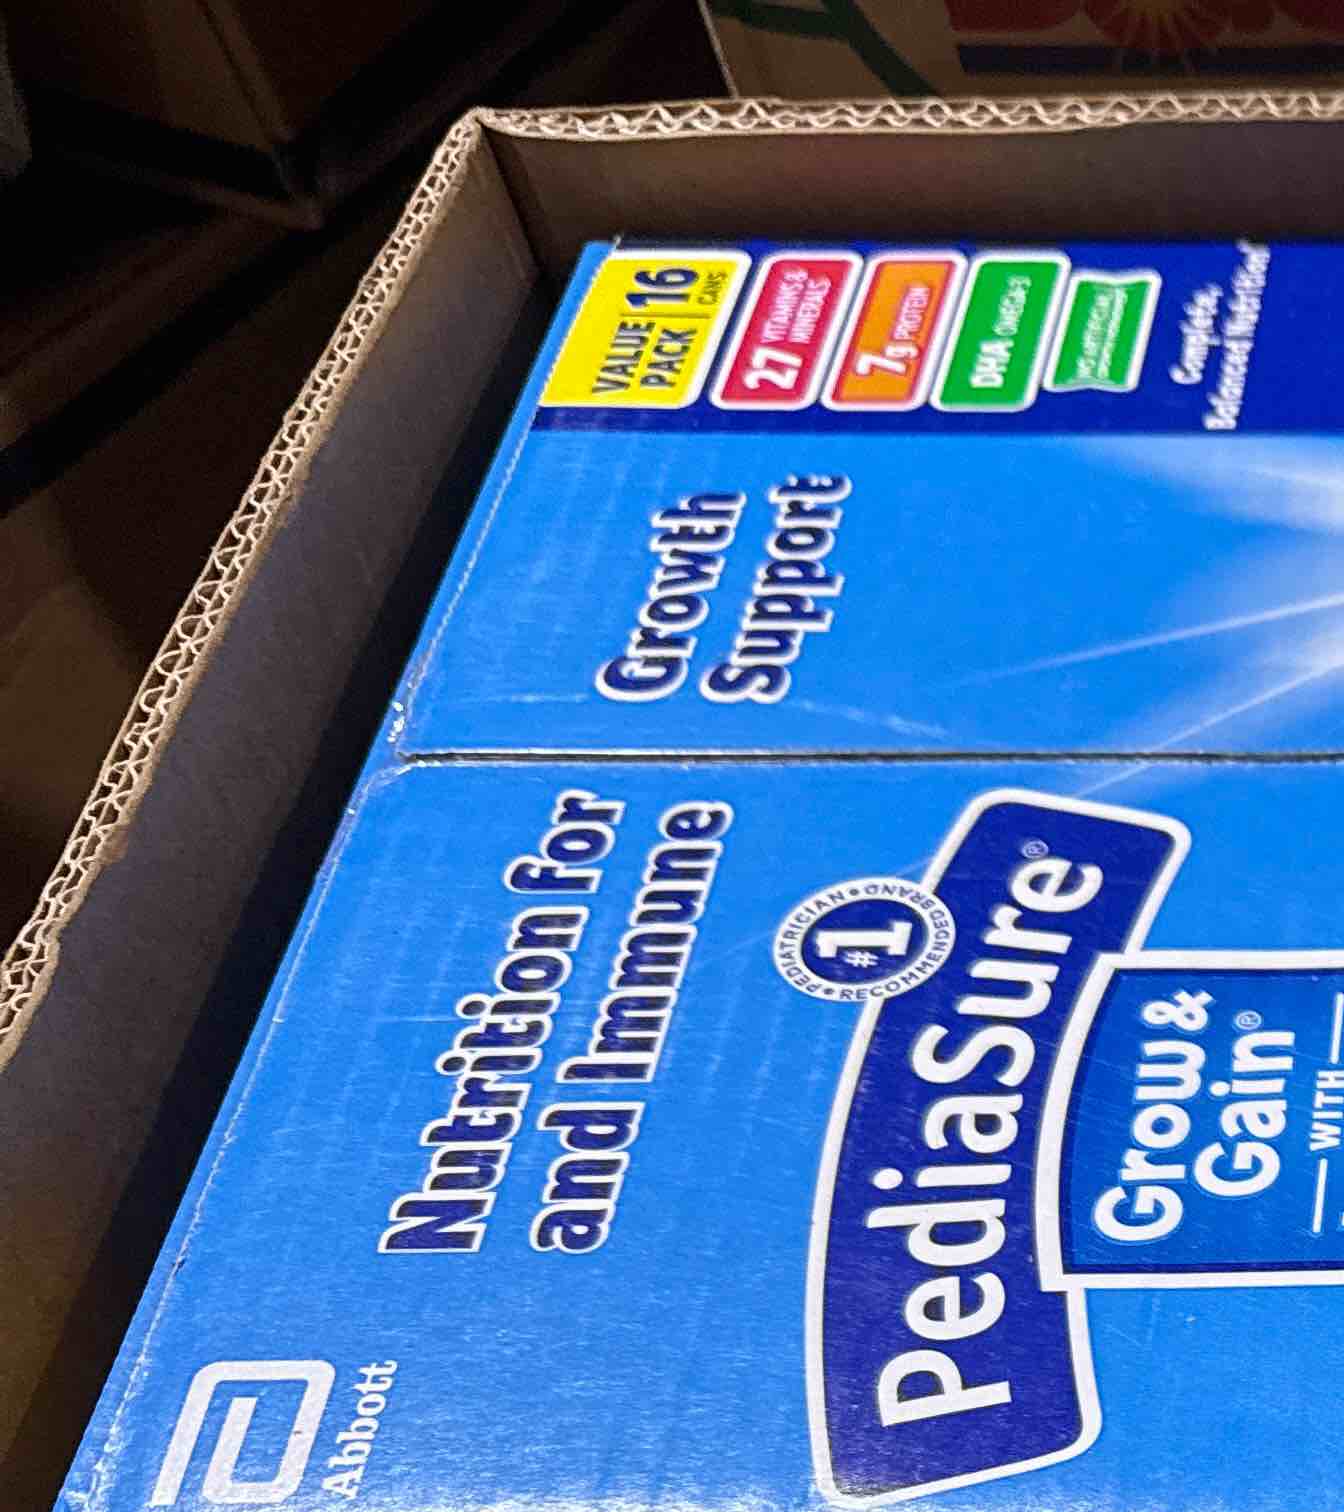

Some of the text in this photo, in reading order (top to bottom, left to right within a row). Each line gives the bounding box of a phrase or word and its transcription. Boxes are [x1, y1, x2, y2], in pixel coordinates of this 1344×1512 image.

[625, 267, 699, 309] 16
[697, 270, 728, 306] CANS
[855, 285, 931, 377] 7g PROTEIN
[592, 321, 656, 395] VALUE
[640, 327, 698, 389] PACK
[744, 346, 803, 390] 27
[970, 341, 1015, 388] DHA
[600, 491, 745, 701] Growth
[703, 475, 849, 702] Support
[778, 891, 846, 994] PEDIATRICIAN
[816, 921, 913, 969] #1
[840, 884, 950, 999] RECOMMENDED BRAND
[378, 790, 624, 1253] Nutrition for
[531, 801, 732, 1252] and Immune
[1093, 989, 1218, 1242] Grow &
[323, 1361, 397, 1500] Abbott
